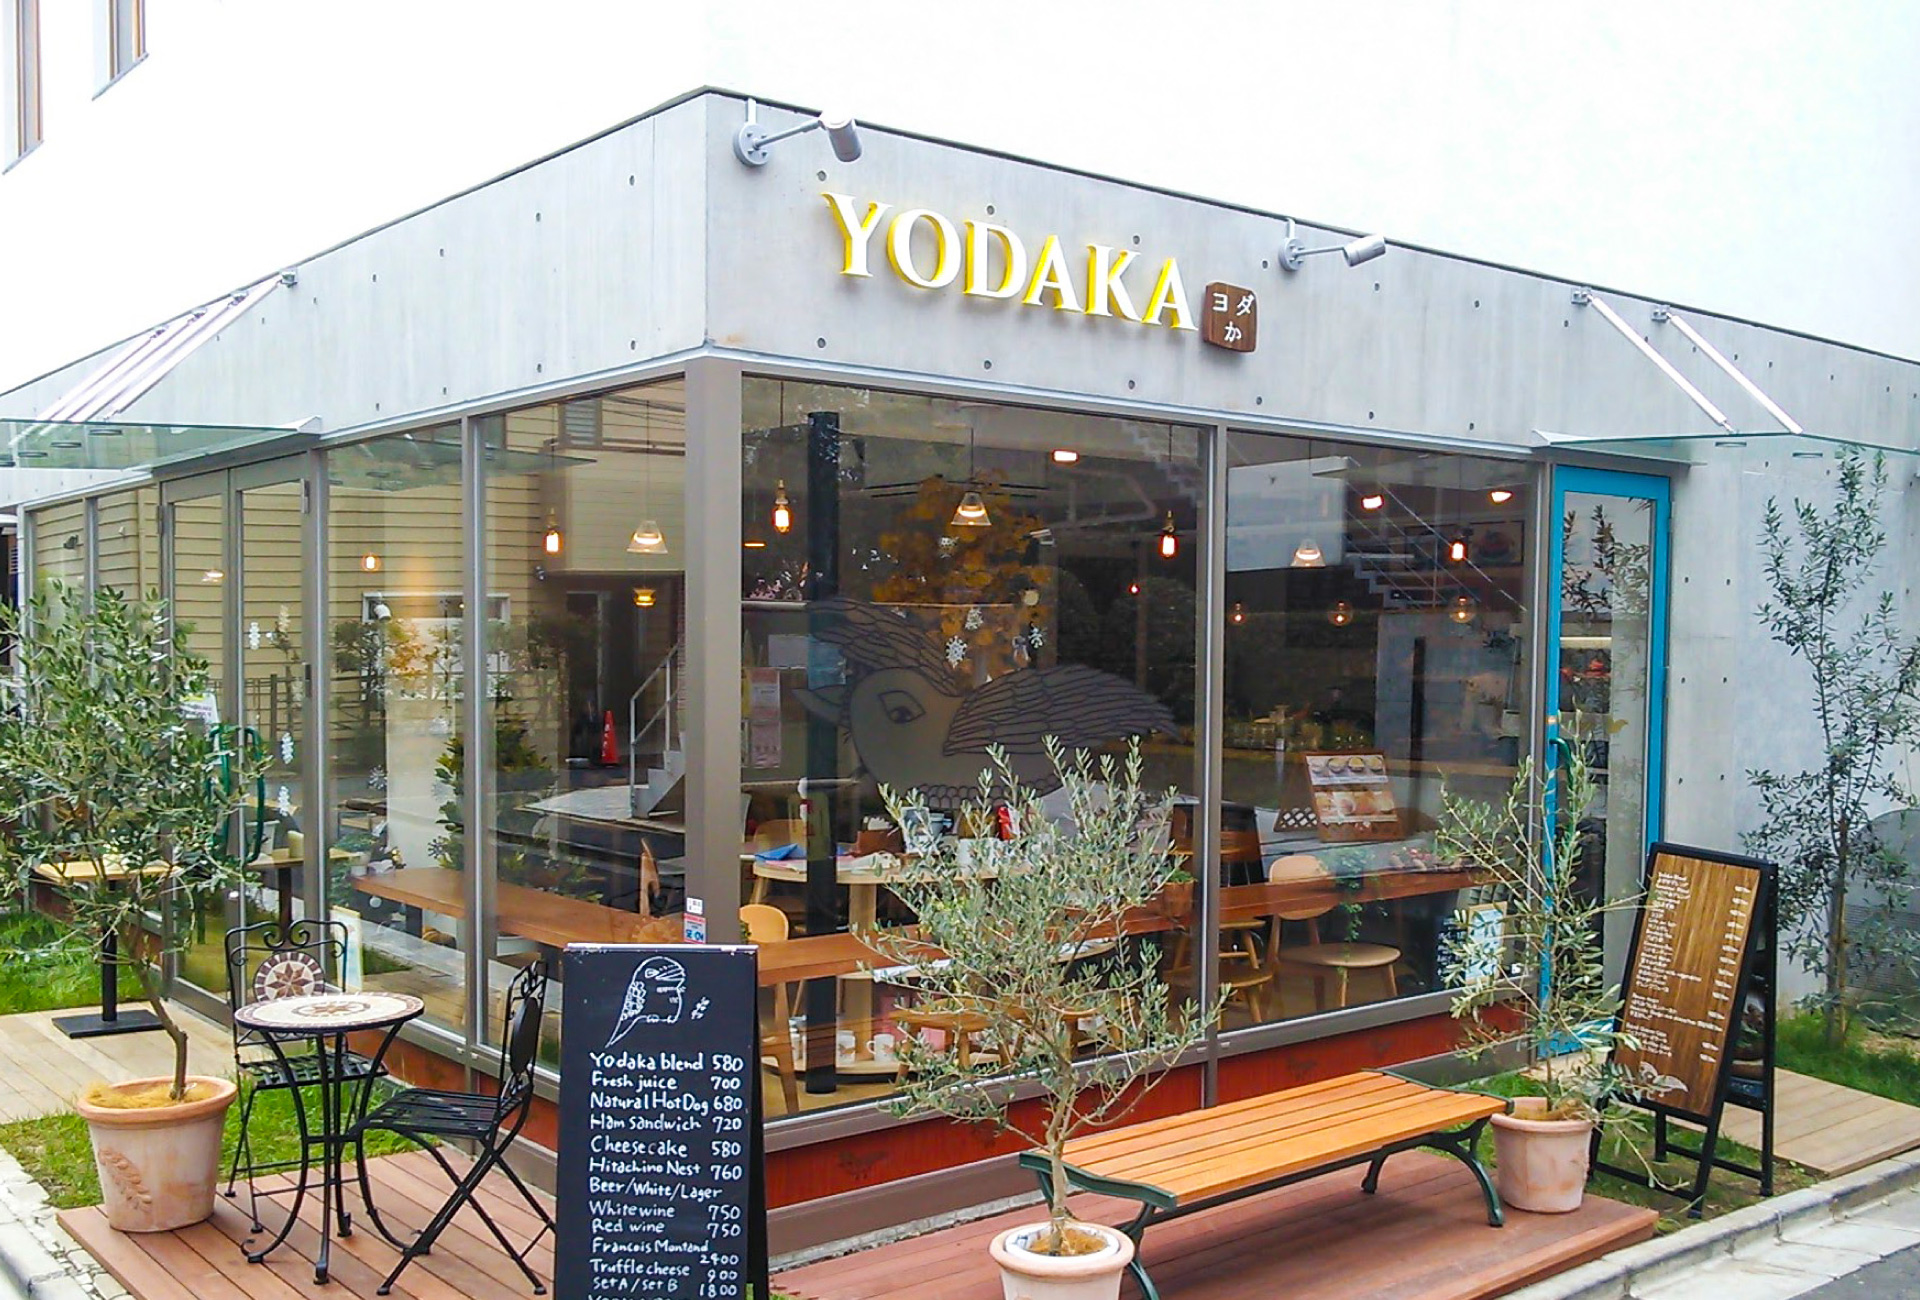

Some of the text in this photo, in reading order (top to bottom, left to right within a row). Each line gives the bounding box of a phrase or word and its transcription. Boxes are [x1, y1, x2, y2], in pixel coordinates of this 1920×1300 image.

[820, 192, 1198, 331] YODAKA
[590, 1051, 744, 1072] Yodaka blend 580
[591, 1071, 741, 1093] Fresh juice 700
[590, 1092, 649, 1109] Natural
[713, 1096, 743, 1112] 680
[590, 1114, 625, 1130] Ham
[712, 1117, 742, 1133] 720
[711, 1141, 741, 1158] 580
[589, 1157, 742, 1181] Hitachino Nest 760
[708, 1205, 741, 1221] 750
[591, 1218, 741, 1239] Red wine 750
[707, 1269, 738, 1283] 900
[699, 1283, 738, 1298] 1800
